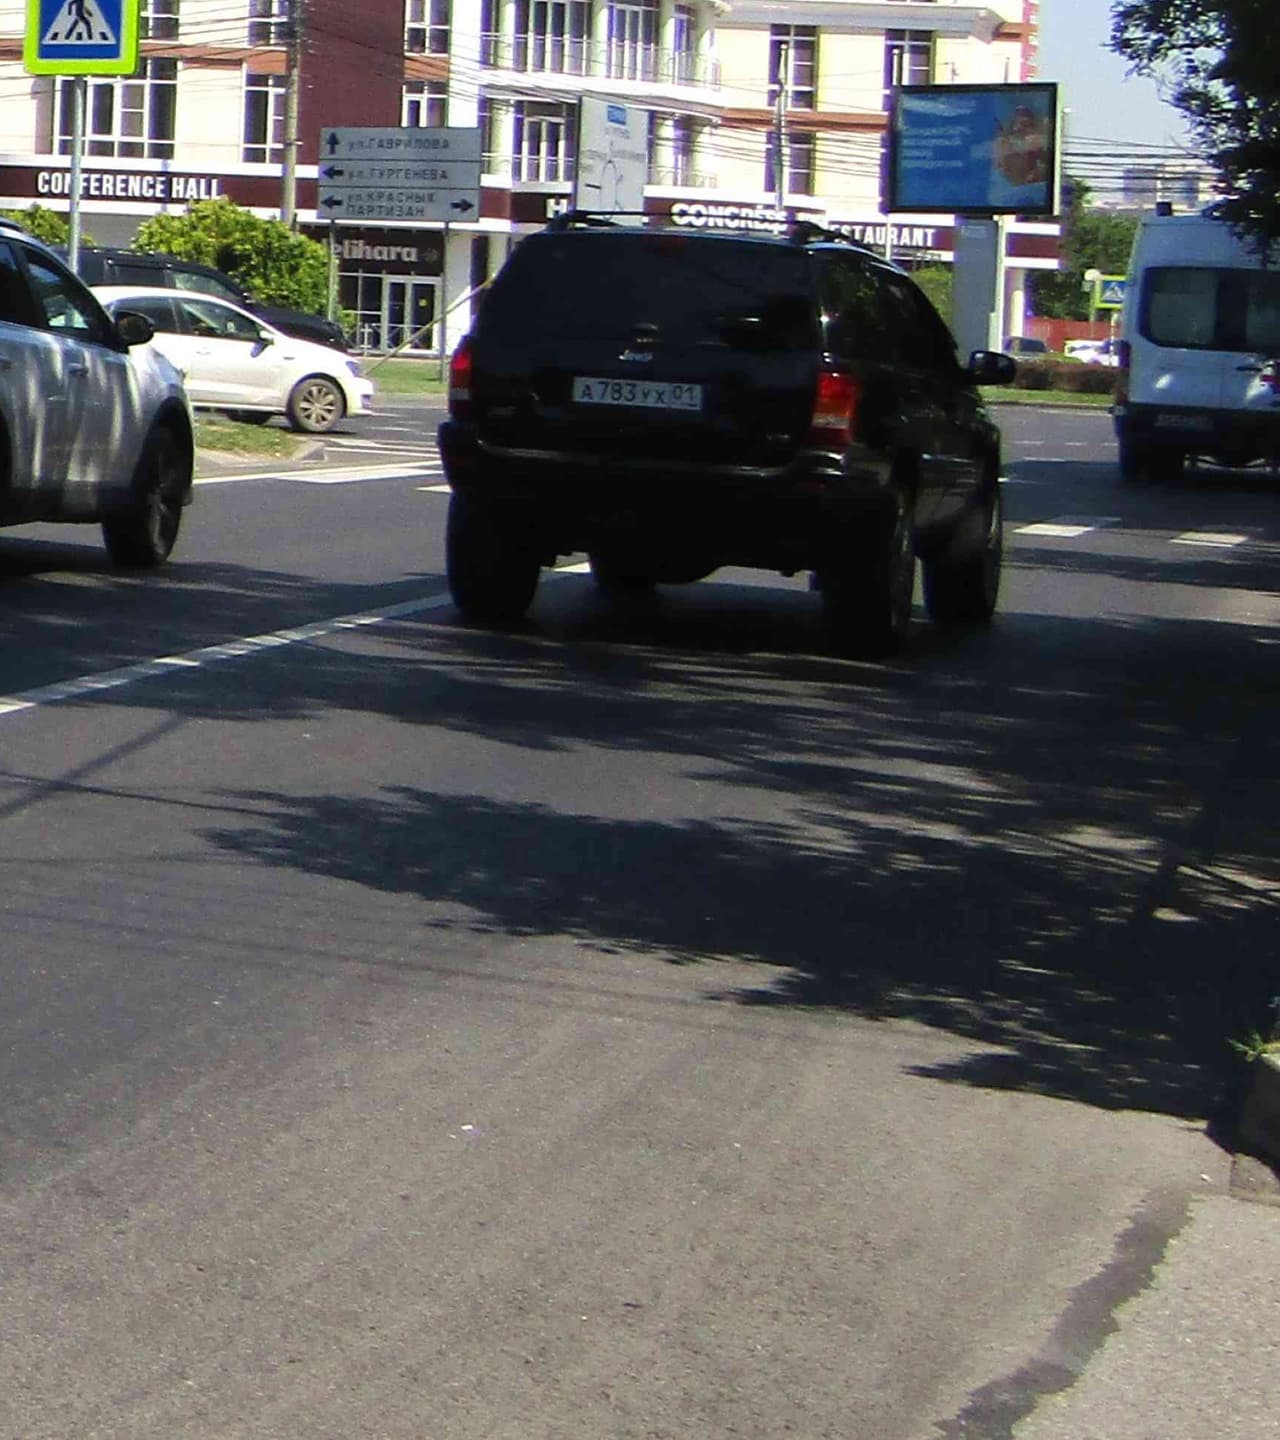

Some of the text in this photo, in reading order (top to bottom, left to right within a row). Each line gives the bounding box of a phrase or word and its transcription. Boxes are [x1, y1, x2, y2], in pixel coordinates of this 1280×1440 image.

[37, 171, 224, 200] CONFERENCE HALL
[347, 205, 425, 217] ПАРТИЗАН
[828, 223, 937, 248] STAURANT
[326, 239, 419, 262] elihara
